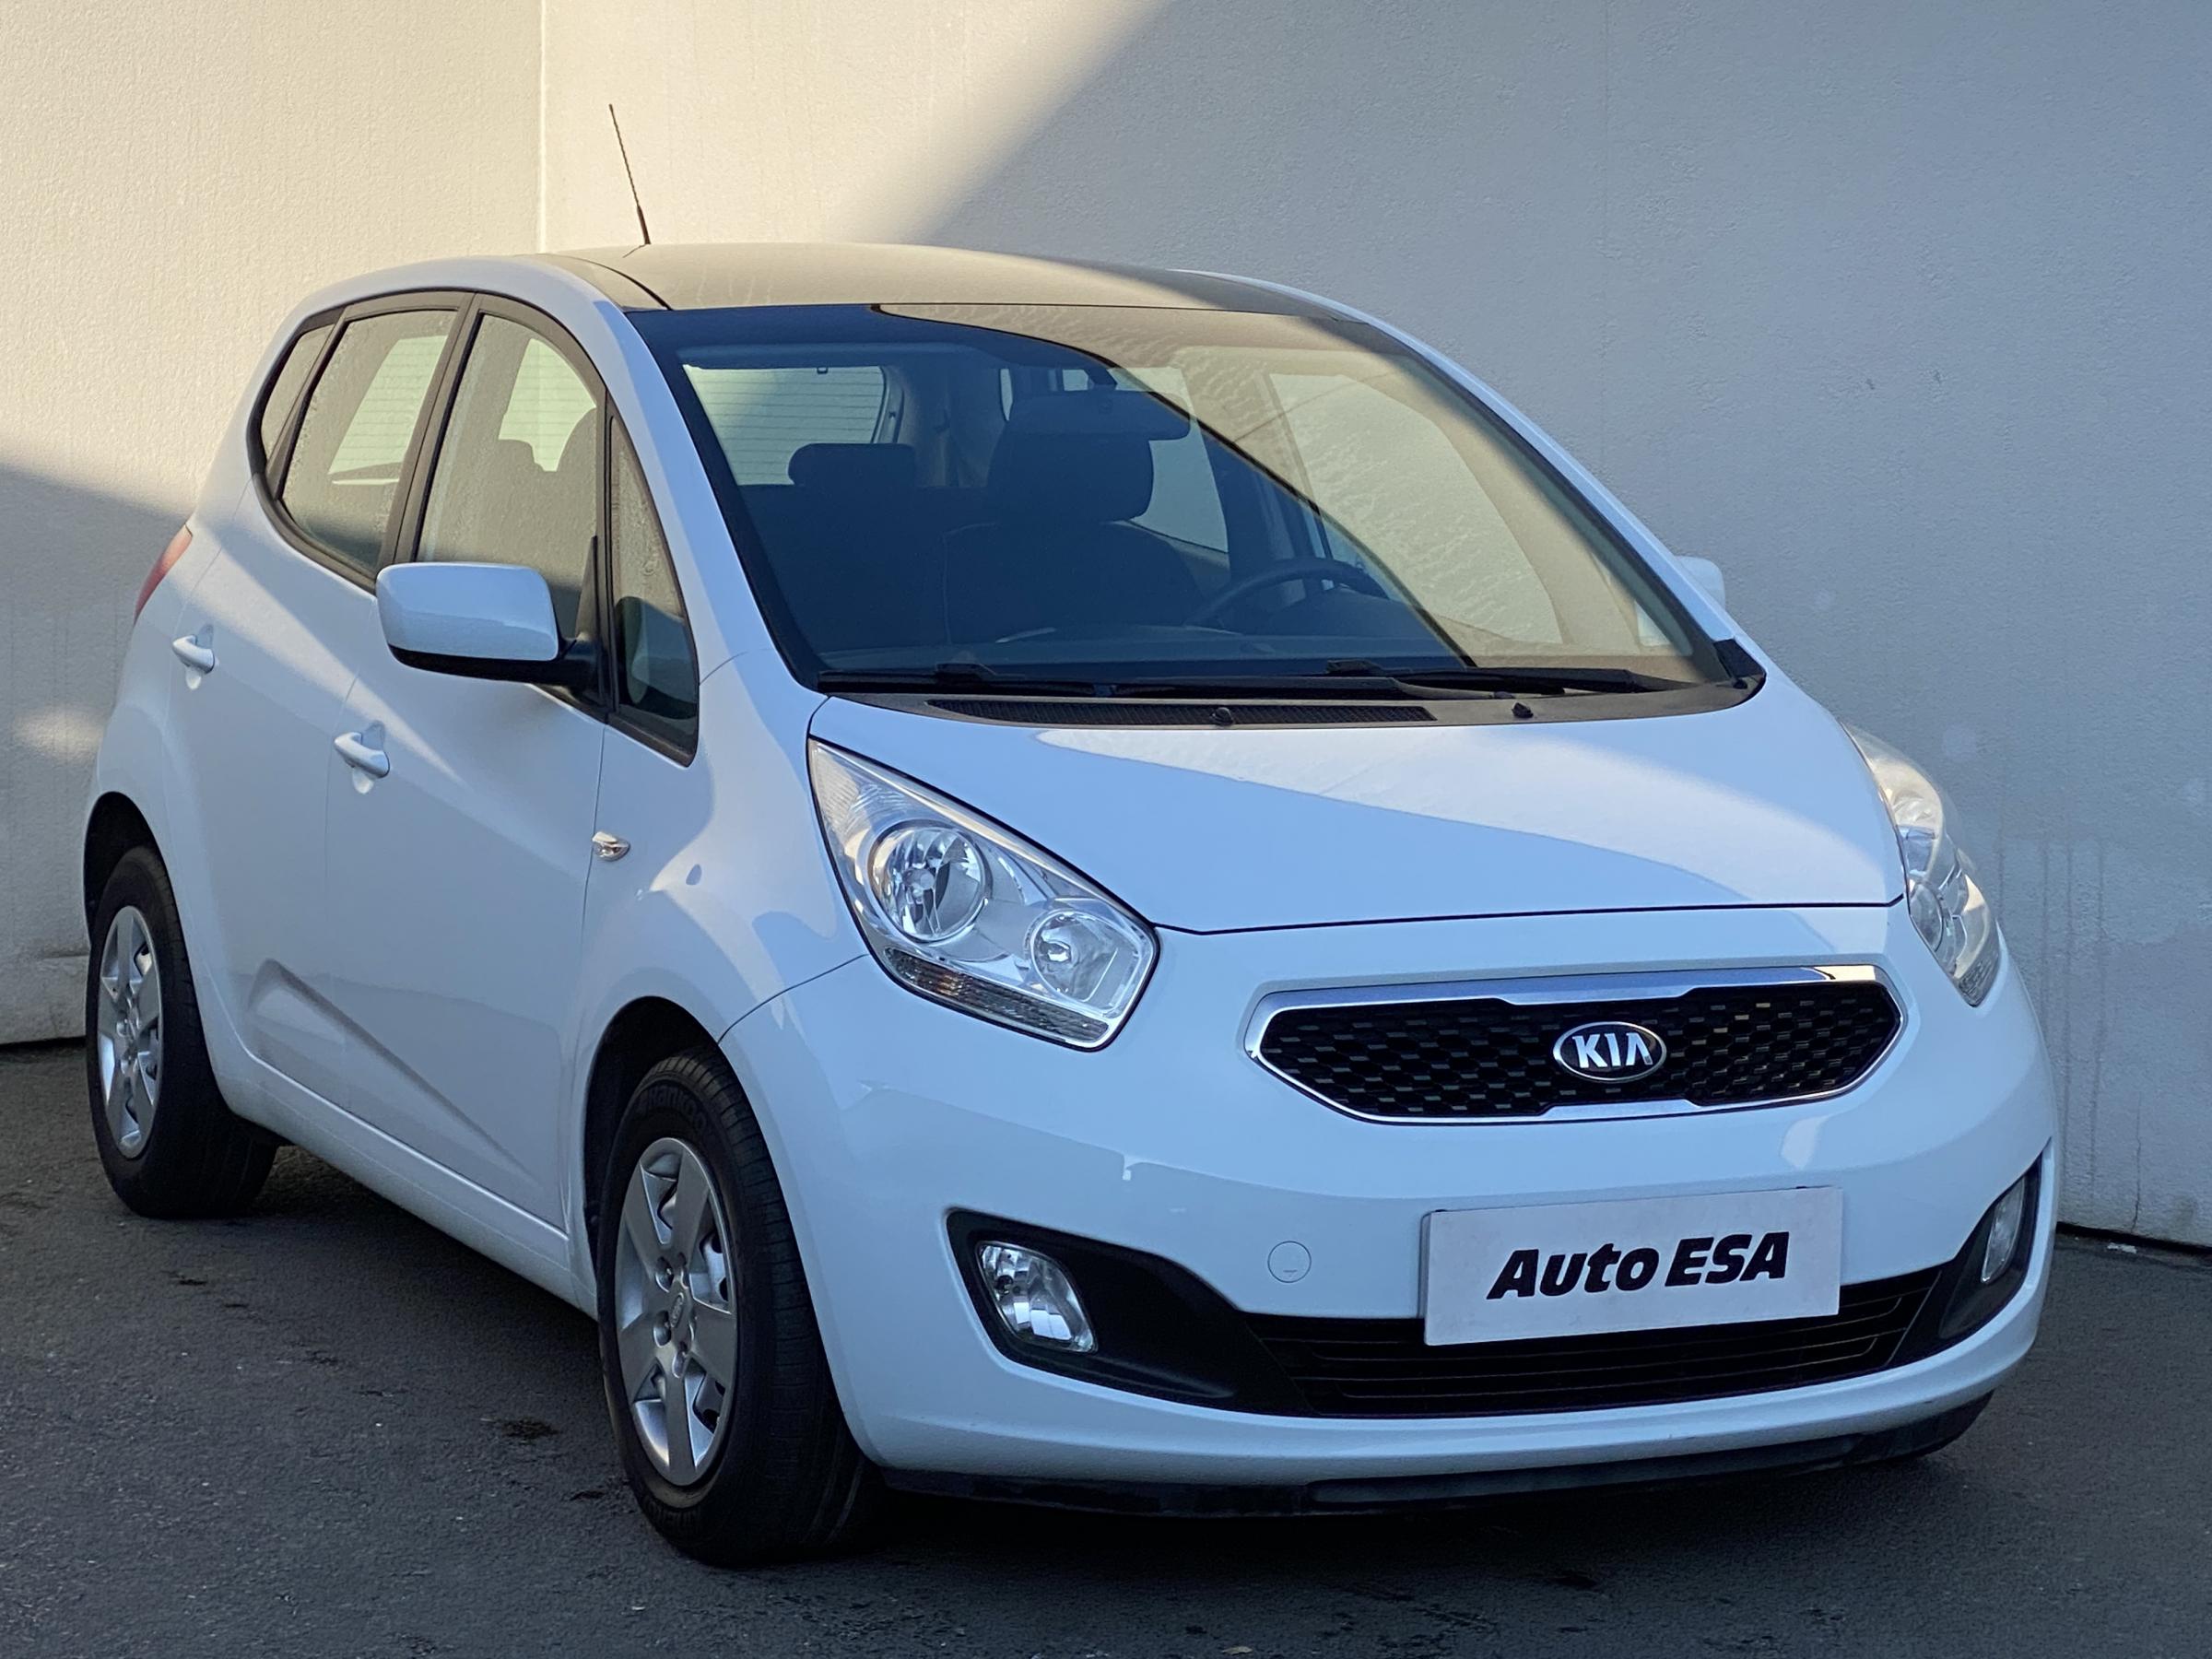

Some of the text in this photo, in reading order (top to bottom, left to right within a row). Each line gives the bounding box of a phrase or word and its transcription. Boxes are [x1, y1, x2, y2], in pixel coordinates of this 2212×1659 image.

[1572, 1032, 1653, 1068] KIA
[648, 1085, 711, 1139] Hankoo
[1487, 1231, 1790, 1300] Auto ESA
